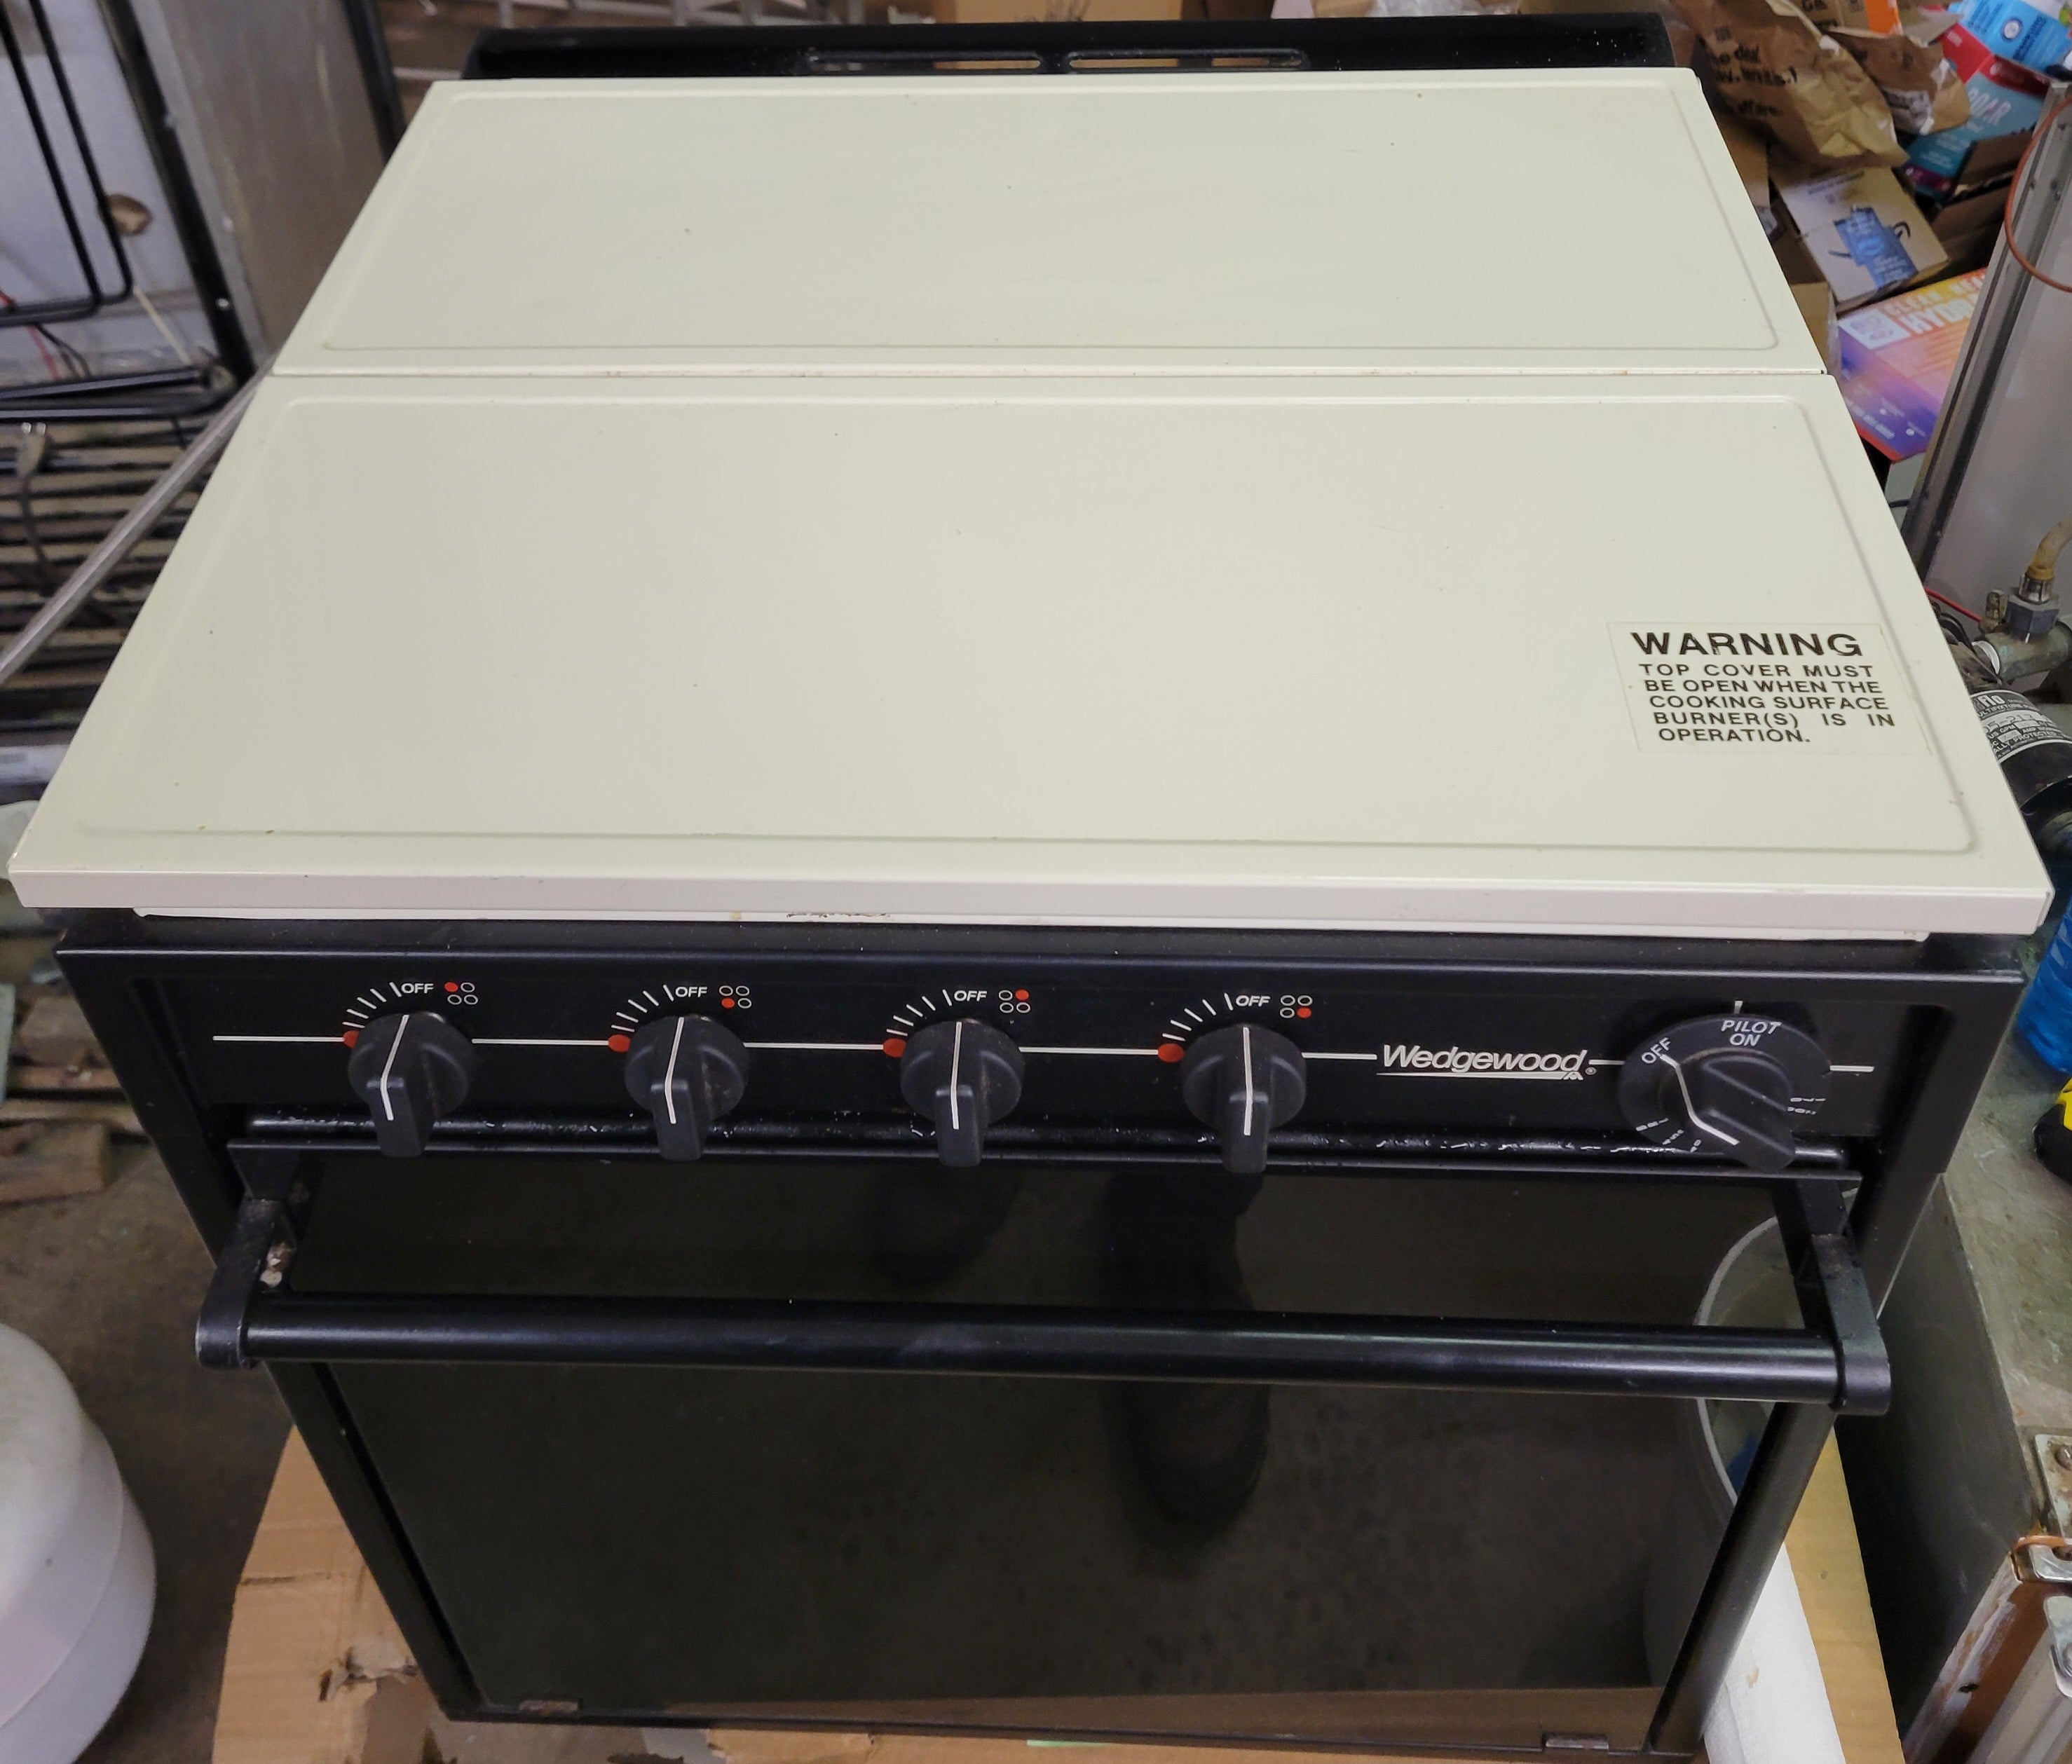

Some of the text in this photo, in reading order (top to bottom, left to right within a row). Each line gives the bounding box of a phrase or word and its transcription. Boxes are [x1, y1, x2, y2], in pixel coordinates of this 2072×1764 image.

[1630, 631, 1864, 657] WARNING
[1638, 663, 1873, 678] TOP COVER MUST
[1644, 679, 1883, 694] BE OPEN WHEN THE
[1649, 695, 1889, 710] COOKING SURFACE
[1653, 711, 1895, 729] BURNER(S) IS IN
[1658, 727, 1811, 743] OPERATION.
[400, 983, 435, 995] OFF
[675, 986, 708, 998] OFF
[953, 990, 988, 1002] OFF
[1235, 994, 1271, 1007] OFF
[1721, 1018, 1783, 1034] PILOT
[1729, 1032, 1761, 1047] ON
[1641, 1037, 1672, 1064] OFF
[1382, 1044, 1588, 1074] Wedgewood
